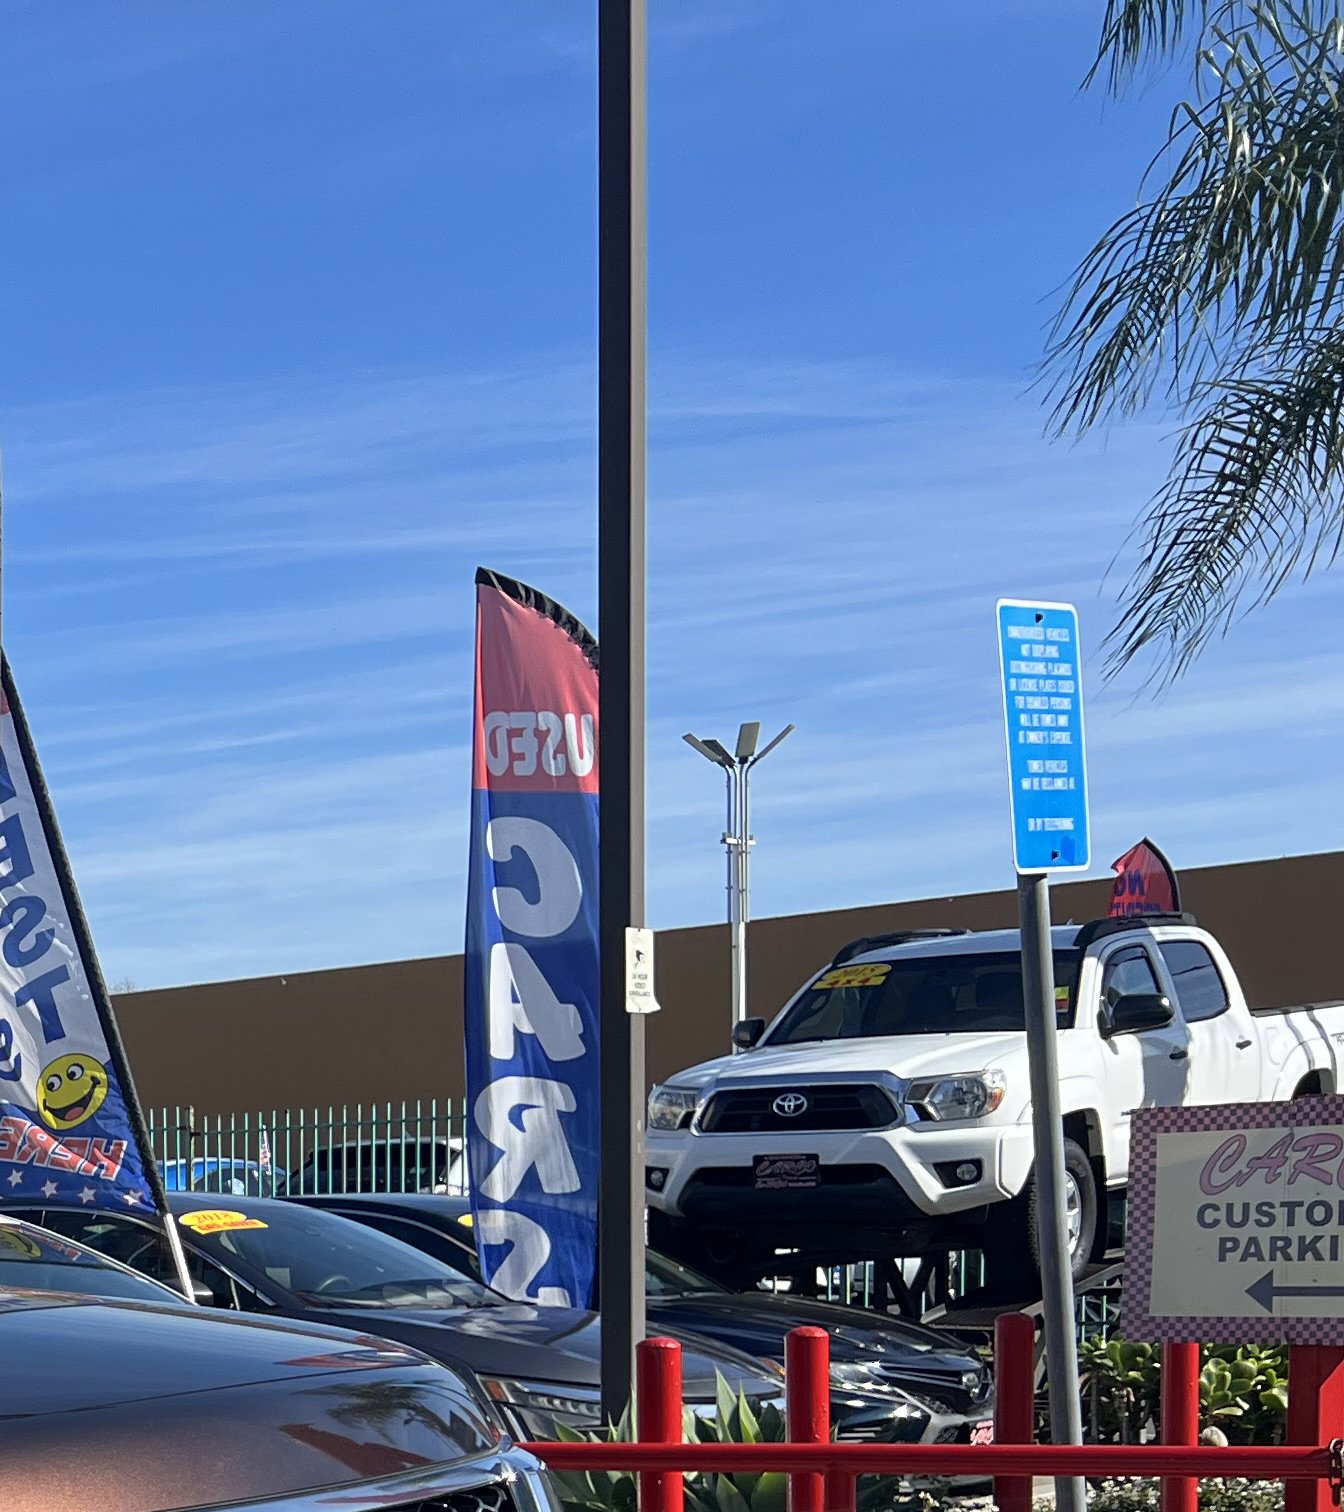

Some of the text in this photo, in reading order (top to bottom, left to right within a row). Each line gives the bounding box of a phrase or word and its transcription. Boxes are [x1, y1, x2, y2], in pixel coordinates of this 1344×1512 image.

[1200, 1133, 1344, 1195] CAR
[1197, 1200, 1344, 1229] CUSTO
[1218, 1234, 1340, 1262] PARKI
